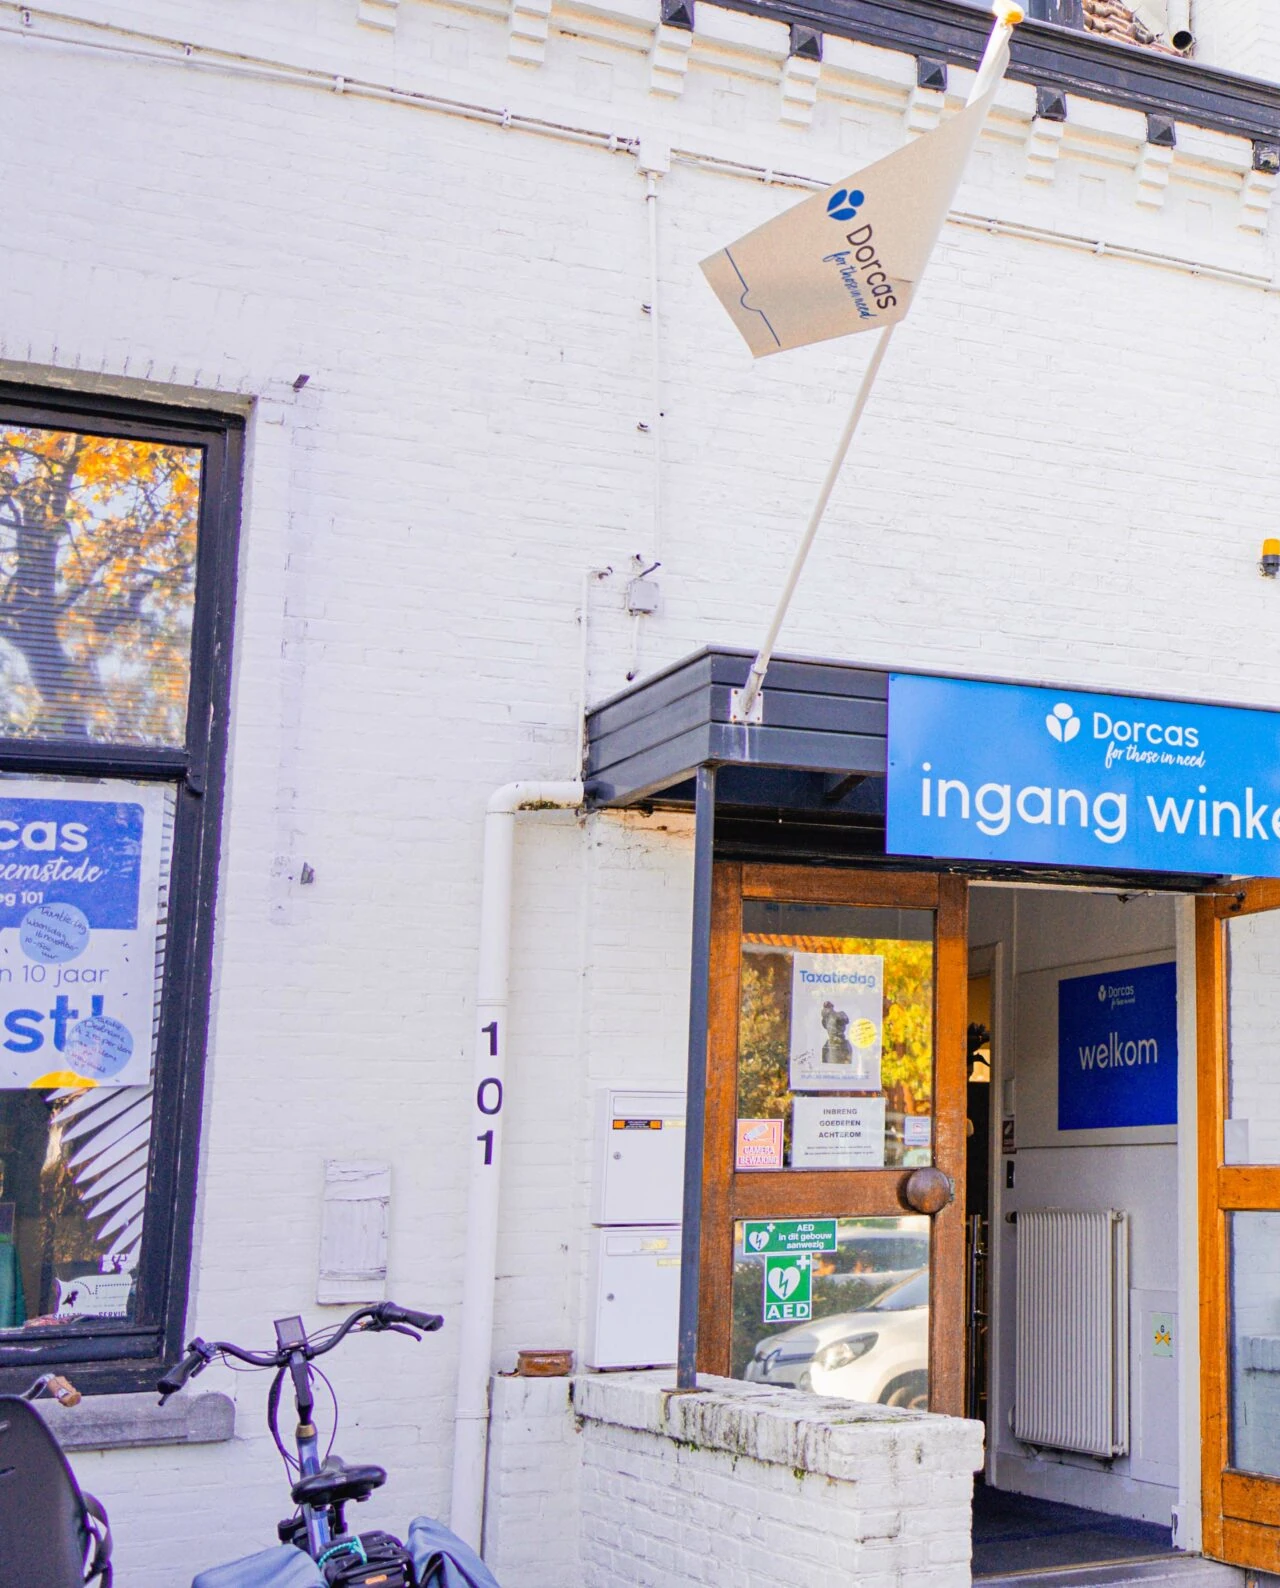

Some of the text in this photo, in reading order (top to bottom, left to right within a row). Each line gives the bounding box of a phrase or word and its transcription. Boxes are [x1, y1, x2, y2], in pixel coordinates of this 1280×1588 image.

[846, 223, 897, 309] Dorcas
[1093, 711, 1200, 748] Dorcas
[1105, 740, 1206, 769] for those in need
[922, 762, 1127, 843] ingang
[21, 890, 44, 905] 101
[22, 964, 46, 983] 10
[53, 963, 110, 988] jaar
[799, 970, 876, 988] Taxatiedag
[1108, 986, 1135, 998] Dorcas
[1078, 1031, 1158, 1071] welkom
[823, 1108, 858, 1116] INBRENG
[796, 1224, 815, 1232] AED
[778, 1232, 832, 1242] in dit gebouw
[786, 1241, 825, 1250] aanwezig
[767, 1303, 809, 1319] AED
